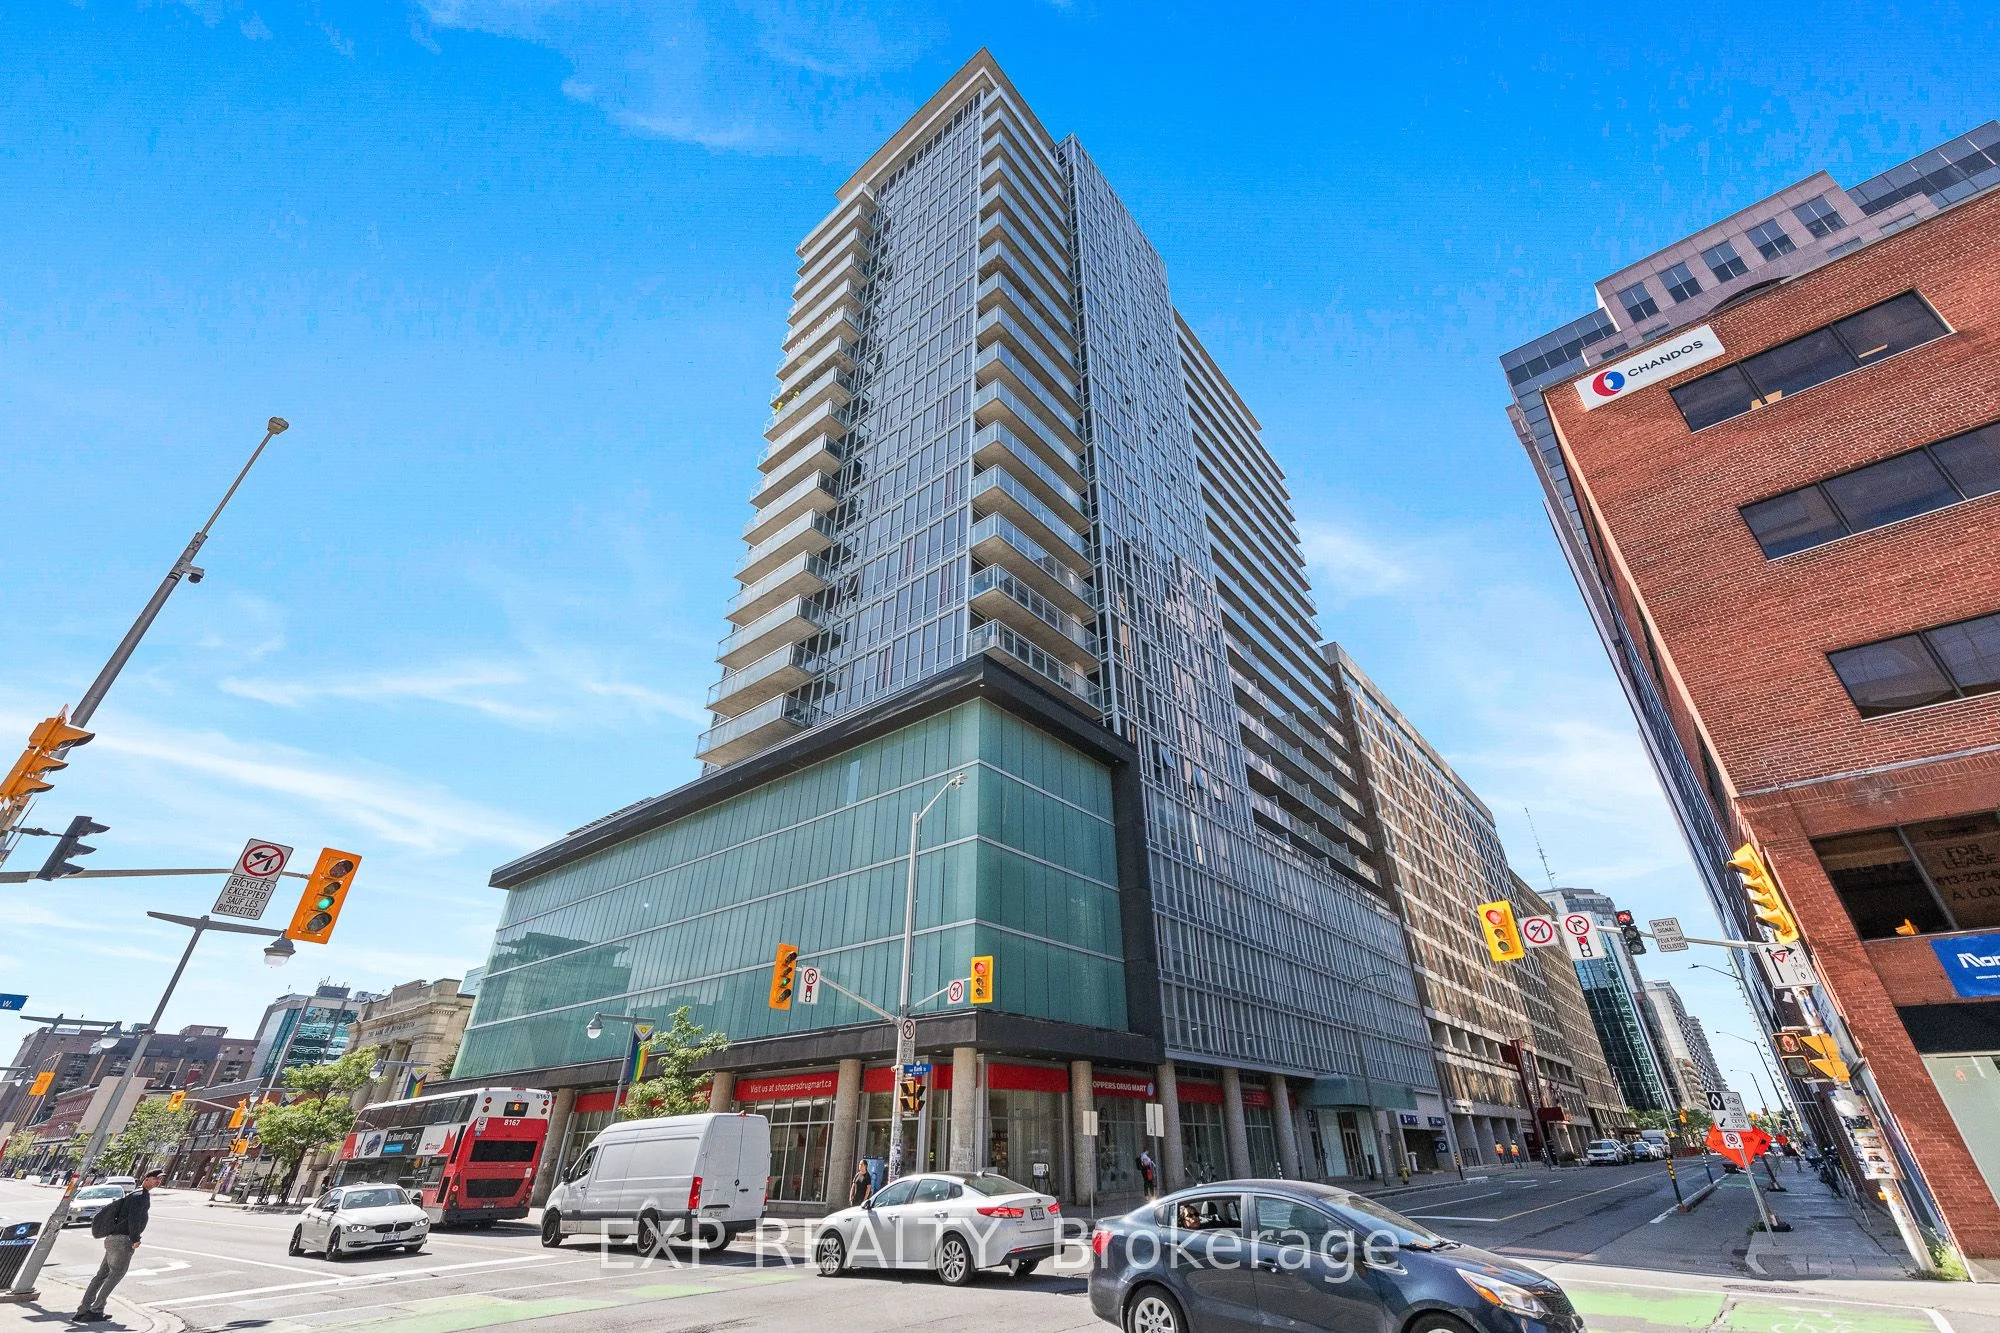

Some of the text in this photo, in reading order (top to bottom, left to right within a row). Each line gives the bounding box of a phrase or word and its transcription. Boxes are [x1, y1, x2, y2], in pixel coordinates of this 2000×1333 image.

[1628, 340, 1704, 377] CHANDOS
[1945, 844, 1983, 858] FOR
[1942, 853, 1997, 870] LEASE
[231, 878, 271, 892] BICYCLES
[227, 886, 267, 900] EXCEPTED
[225, 896, 260, 909] SAUF LES
[216, 903, 259, 917] BICYCLETTES
[1653, 920, 1675, 928] BICYCLE
[1660, 942, 1686, 950] CYCLISTES
[750, 1084, 761, 1093] Visit
[768, 1084, 775, 1092] at
[775, 1080, 832, 1092] shoppersdrugmart.ca
[1131, 1084, 1146, 1092] MART
[513, 1103, 520, 1111] 6
